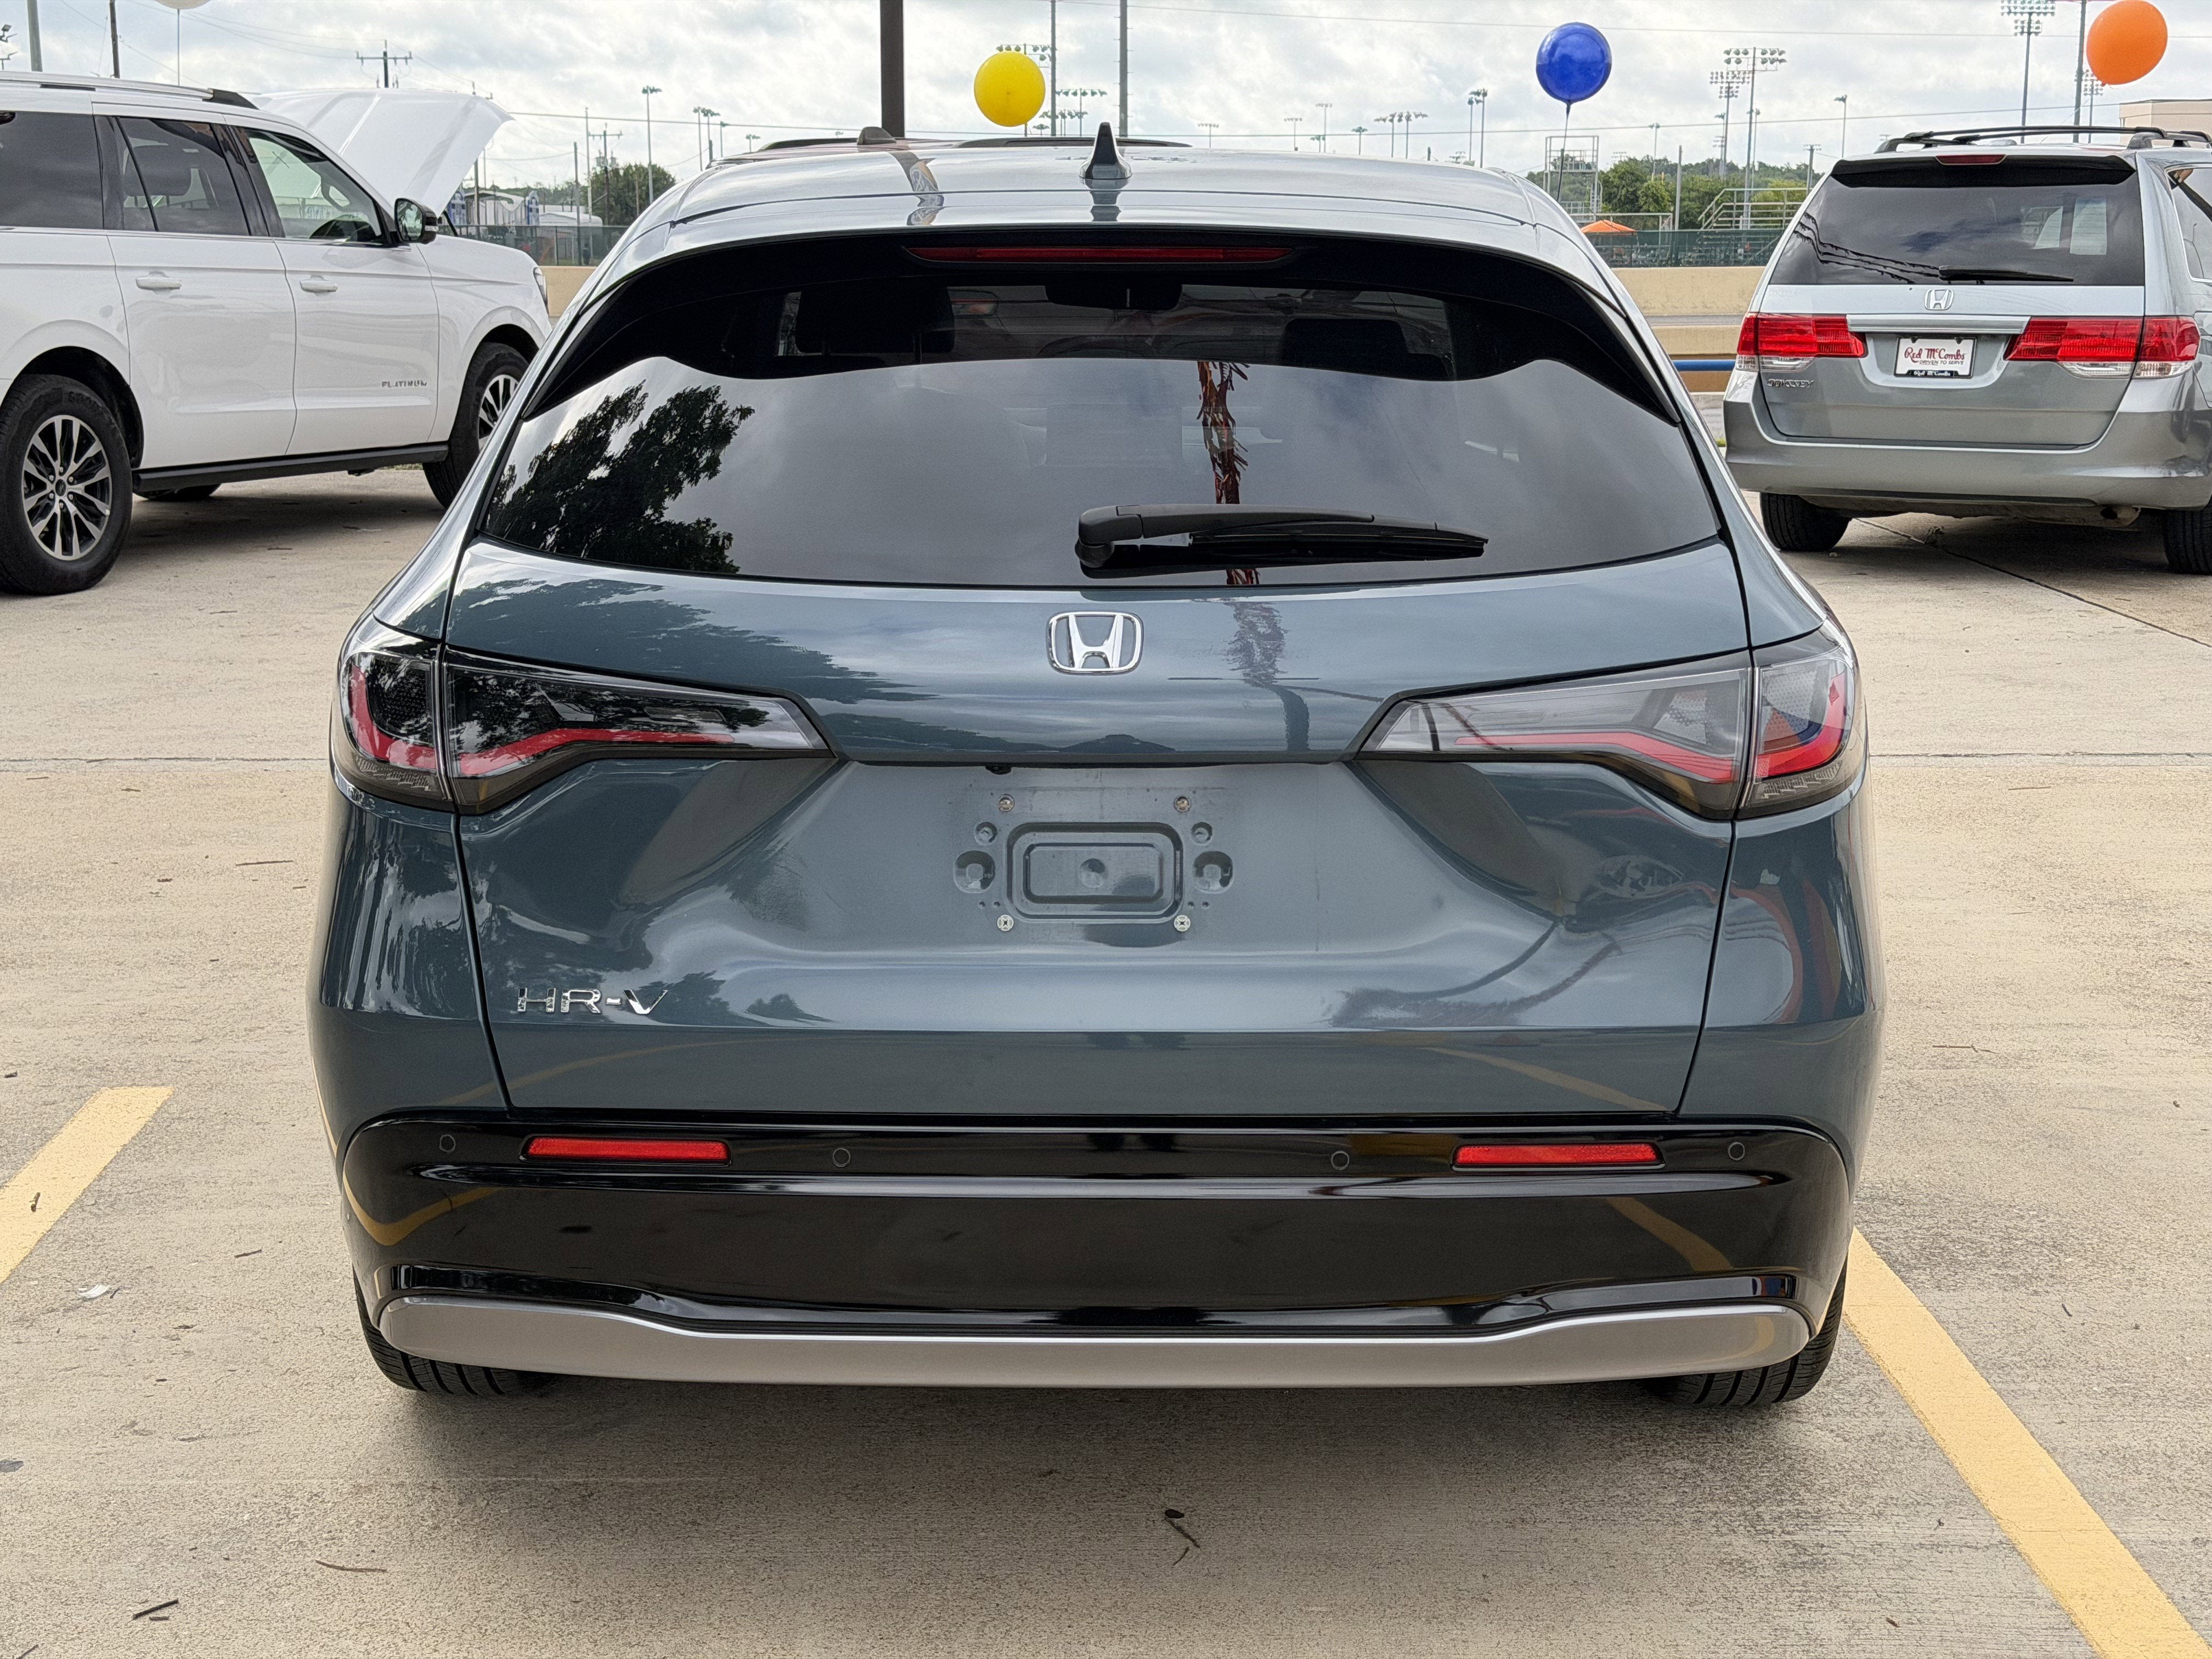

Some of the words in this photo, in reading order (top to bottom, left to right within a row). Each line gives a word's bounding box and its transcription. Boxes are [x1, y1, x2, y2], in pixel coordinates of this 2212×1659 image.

[1904, 347, 1923, 363] Red
[1925, 348, 1966, 360] McCombs
[517, 988, 669, 1015] HR-V
